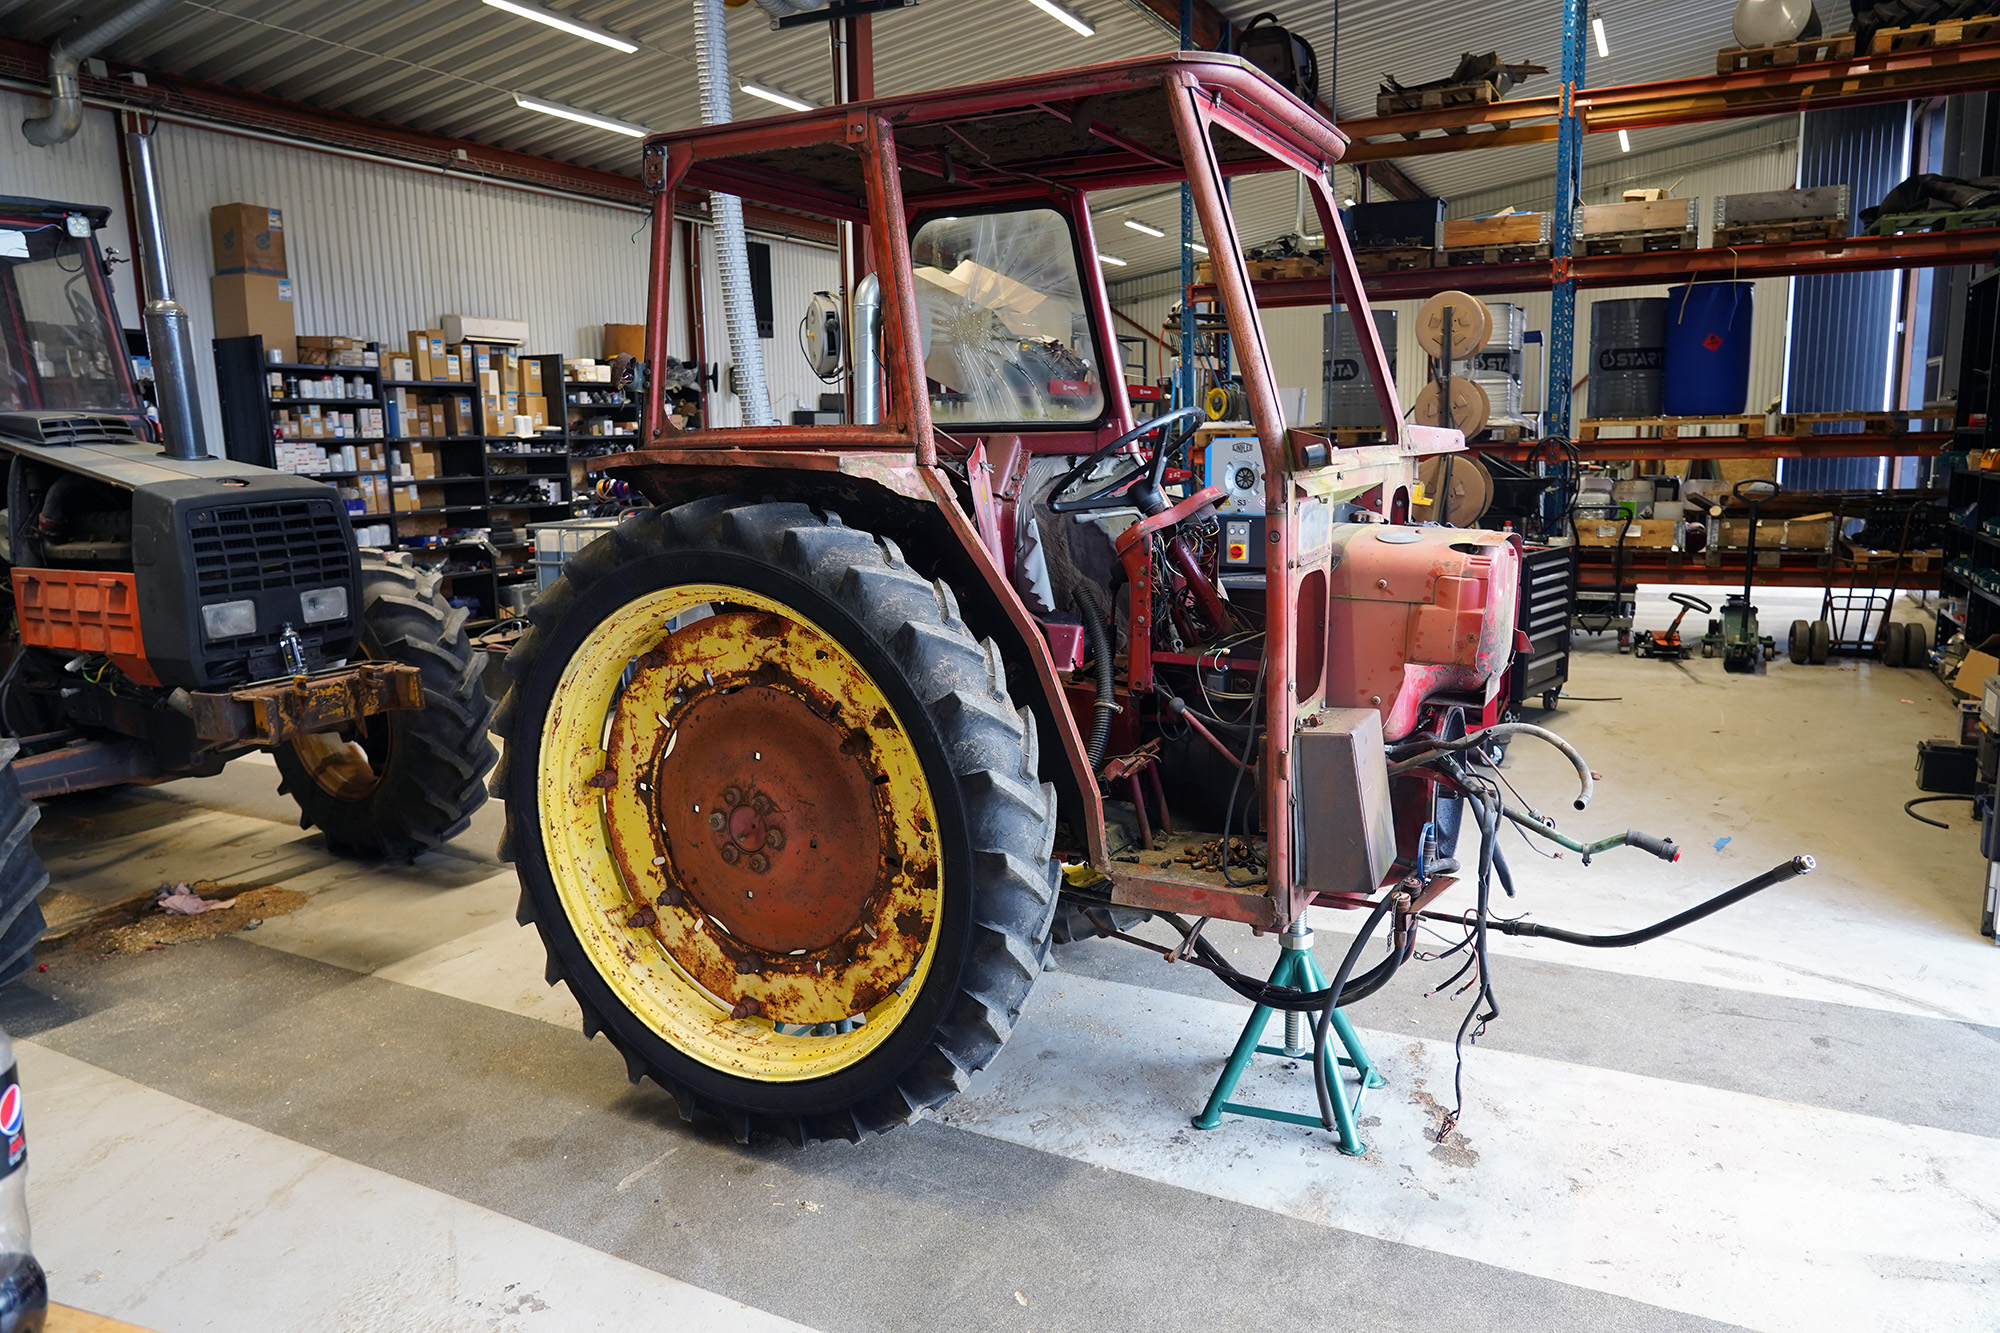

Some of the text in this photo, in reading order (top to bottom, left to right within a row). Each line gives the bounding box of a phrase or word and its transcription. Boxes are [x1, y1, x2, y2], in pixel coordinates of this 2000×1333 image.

[1616, 352, 1665, 367] START
[1324, 363, 1354, 377] ARTA
[1237, 499, 1247, 507] S3
